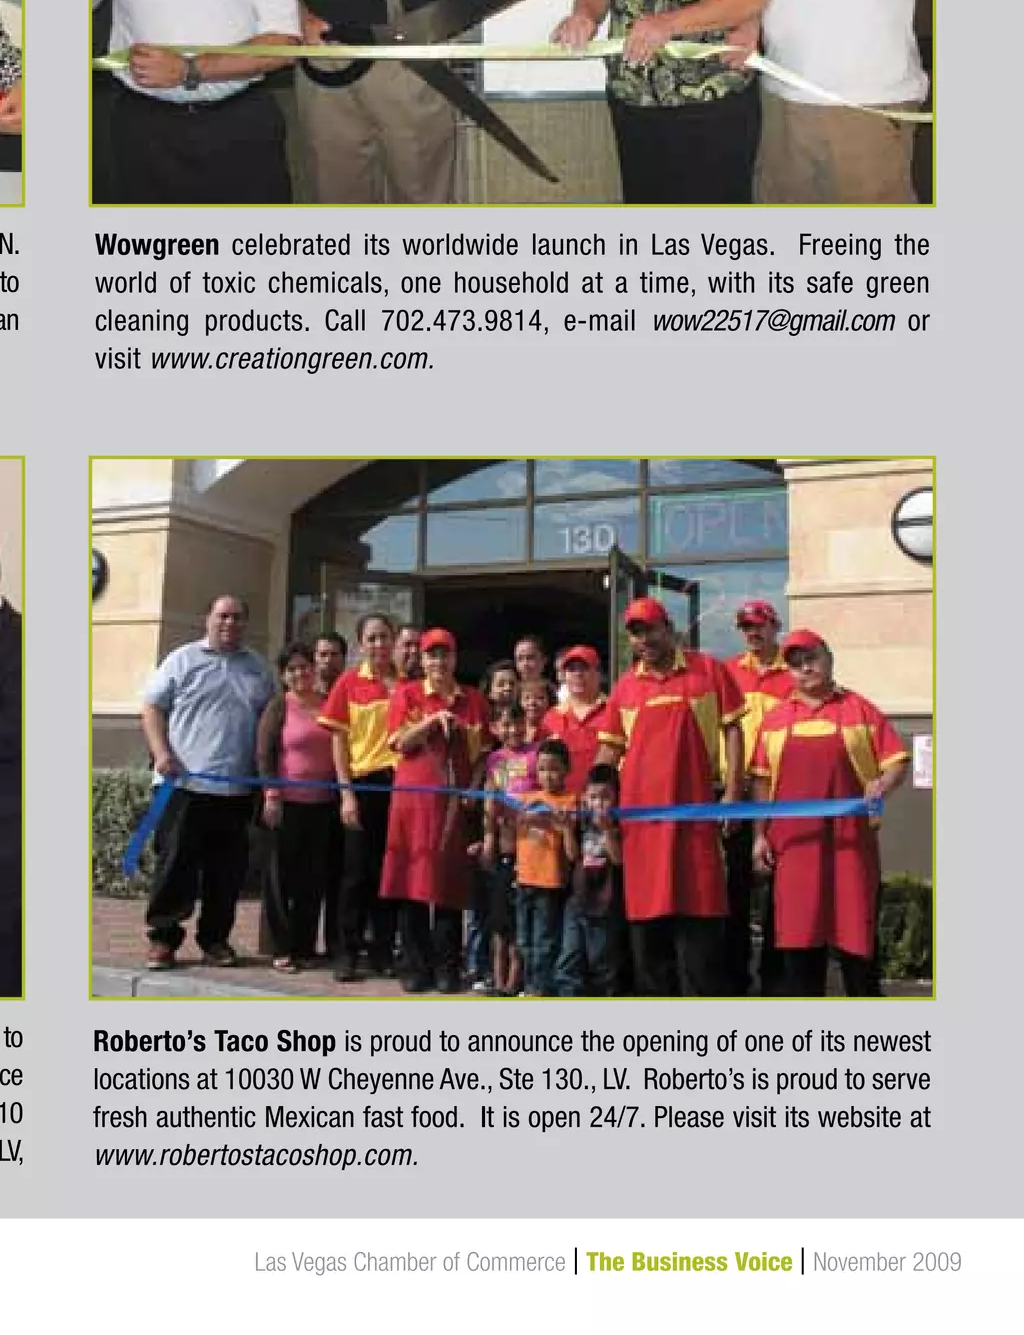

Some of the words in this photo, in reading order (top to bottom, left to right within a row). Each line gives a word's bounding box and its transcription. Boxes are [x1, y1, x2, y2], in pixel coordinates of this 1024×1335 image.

[94, 232, 219, 261] Wowgreen
[231, 232, 351, 256] celebrated
[364, 232, 391, 256] its
[401, 232, 519, 256] worldwide
[532, 232, 606, 256] launch
[619, 232, 638, 256] in
[651, 232, 690, 256] Las
[700, 232, 775, 261] Vegas.
[799, 232, 882, 261] Freeing
[893, 232, 930, 256] the
[94, 346, 142, 370] visit
[151, 346, 434, 375] www.creationgreen.com.
[557, 523, 616, 554] 130
[2, 1025, 24, 1049] to
[93, 1029, 207, 1053] Roberto's
[213, 1029, 269, 1053] Taco
[276, 1029, 336, 1058] Shop
[345, 1029, 363, 1053] is
[370, 1029, 432, 1058] proud
[438, 1030, 460, 1053] to
[467, 1034, 574, 1053] announce
[580, 1029, 615, 1053] the
[622, 1029, 709, 1058] opening
[716, 1029, 738, 1053] of
[744, 1034, 784, 1053] one
[791, 1029, 813, 1053] of
[820, 1029, 846, 1053] its
[853, 1030, 932, 1053] newest
[94, 1067, 190, 1091] locations
[196, 1068, 219, 1091] at
[225, 1067, 294, 1091] 10030
[299, 1067, 322, 1090] W
[328, 1067, 435, 1095] Cheyenne
[439, 1068, 493, 1092] Ave.,
[499, 1067, 534, 1091] Ste
[541, 1067, 596, 1094] 130.,
[603, 1067, 631, 1090] LV.
[644, 1067, 745, 1091] Roberto's
[752, 1067, 770, 1091] is
[776, 1067, 838, 1095] proud
[844, 1067, 866, 1091] to
[871, 1072, 931, 1091] serve
[96, 1143, 418, 1171] www.robertostacoshop.com.
[255, 1251, 287, 1272] Las
[291, 1251, 347, 1276] Vegas
[354, 1251, 437, 1272] Chamber
[443, 1251, 461, 1272] of
[467, 1251, 566, 1272] Commerce
[585, 1251, 625, 1272] The
[631, 1251, 729, 1273] Business
[734, 1251, 793, 1273] Voice
[814, 1251, 907, 1272] November
[913, 1251, 962, 1272] 2009
